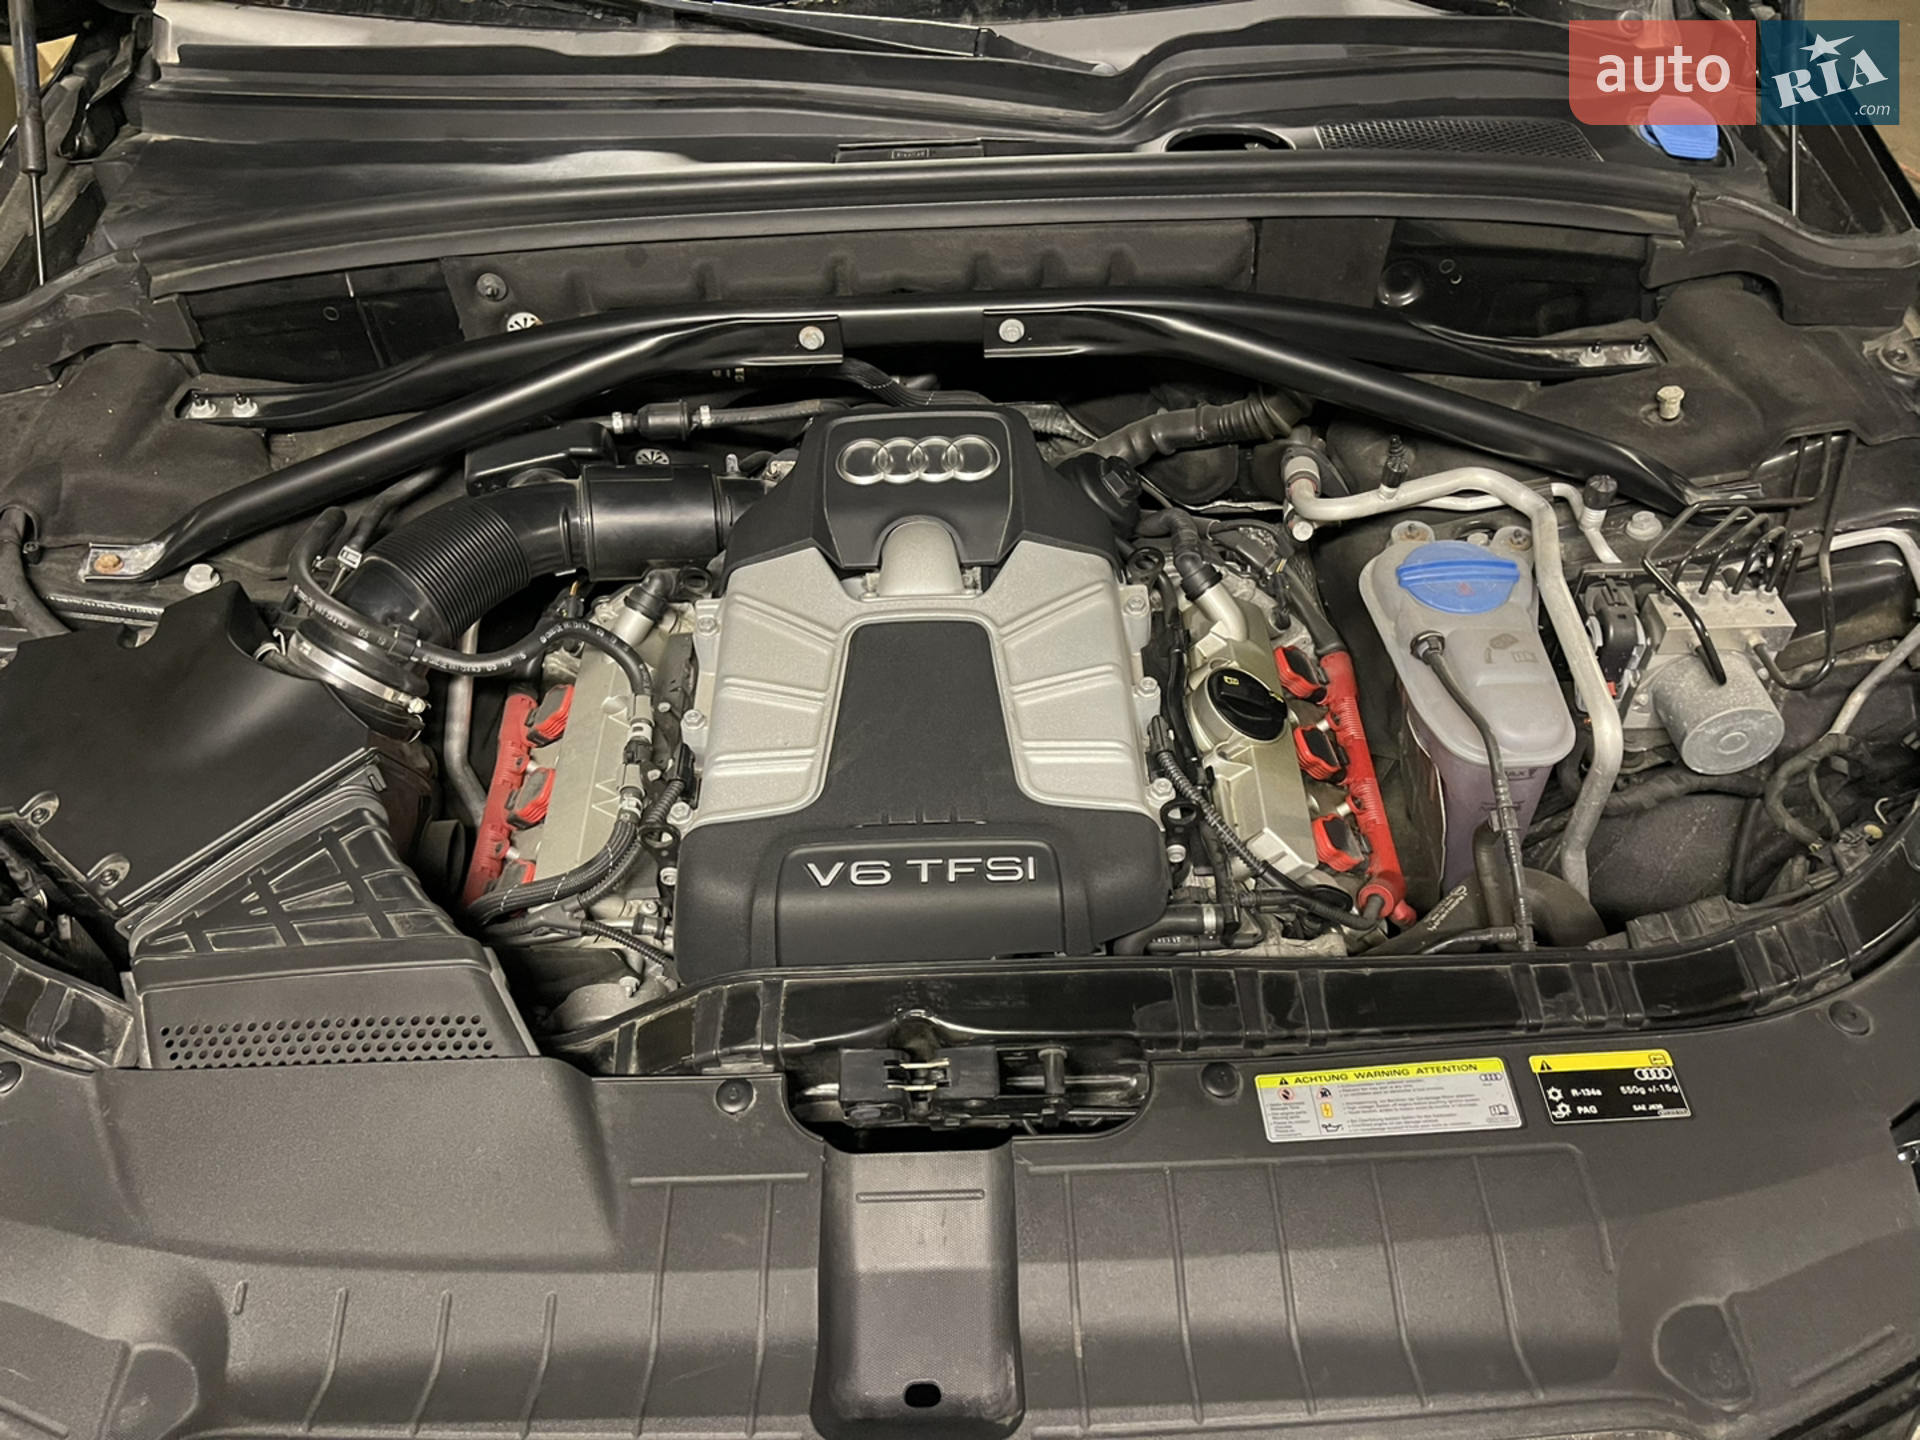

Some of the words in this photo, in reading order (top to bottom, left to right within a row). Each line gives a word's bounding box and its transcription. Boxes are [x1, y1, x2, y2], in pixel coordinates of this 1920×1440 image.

[806, 860, 892, 886] V6
[906, 856, 1035, 883] TFSI
[1294, 1072, 1349, 1084] ACHTUNG
[1353, 1068, 1410, 1080] WARNING
[1416, 1063, 1478, 1075] ATTENTION
[1576, 1105, 1599, 1115] PAG
